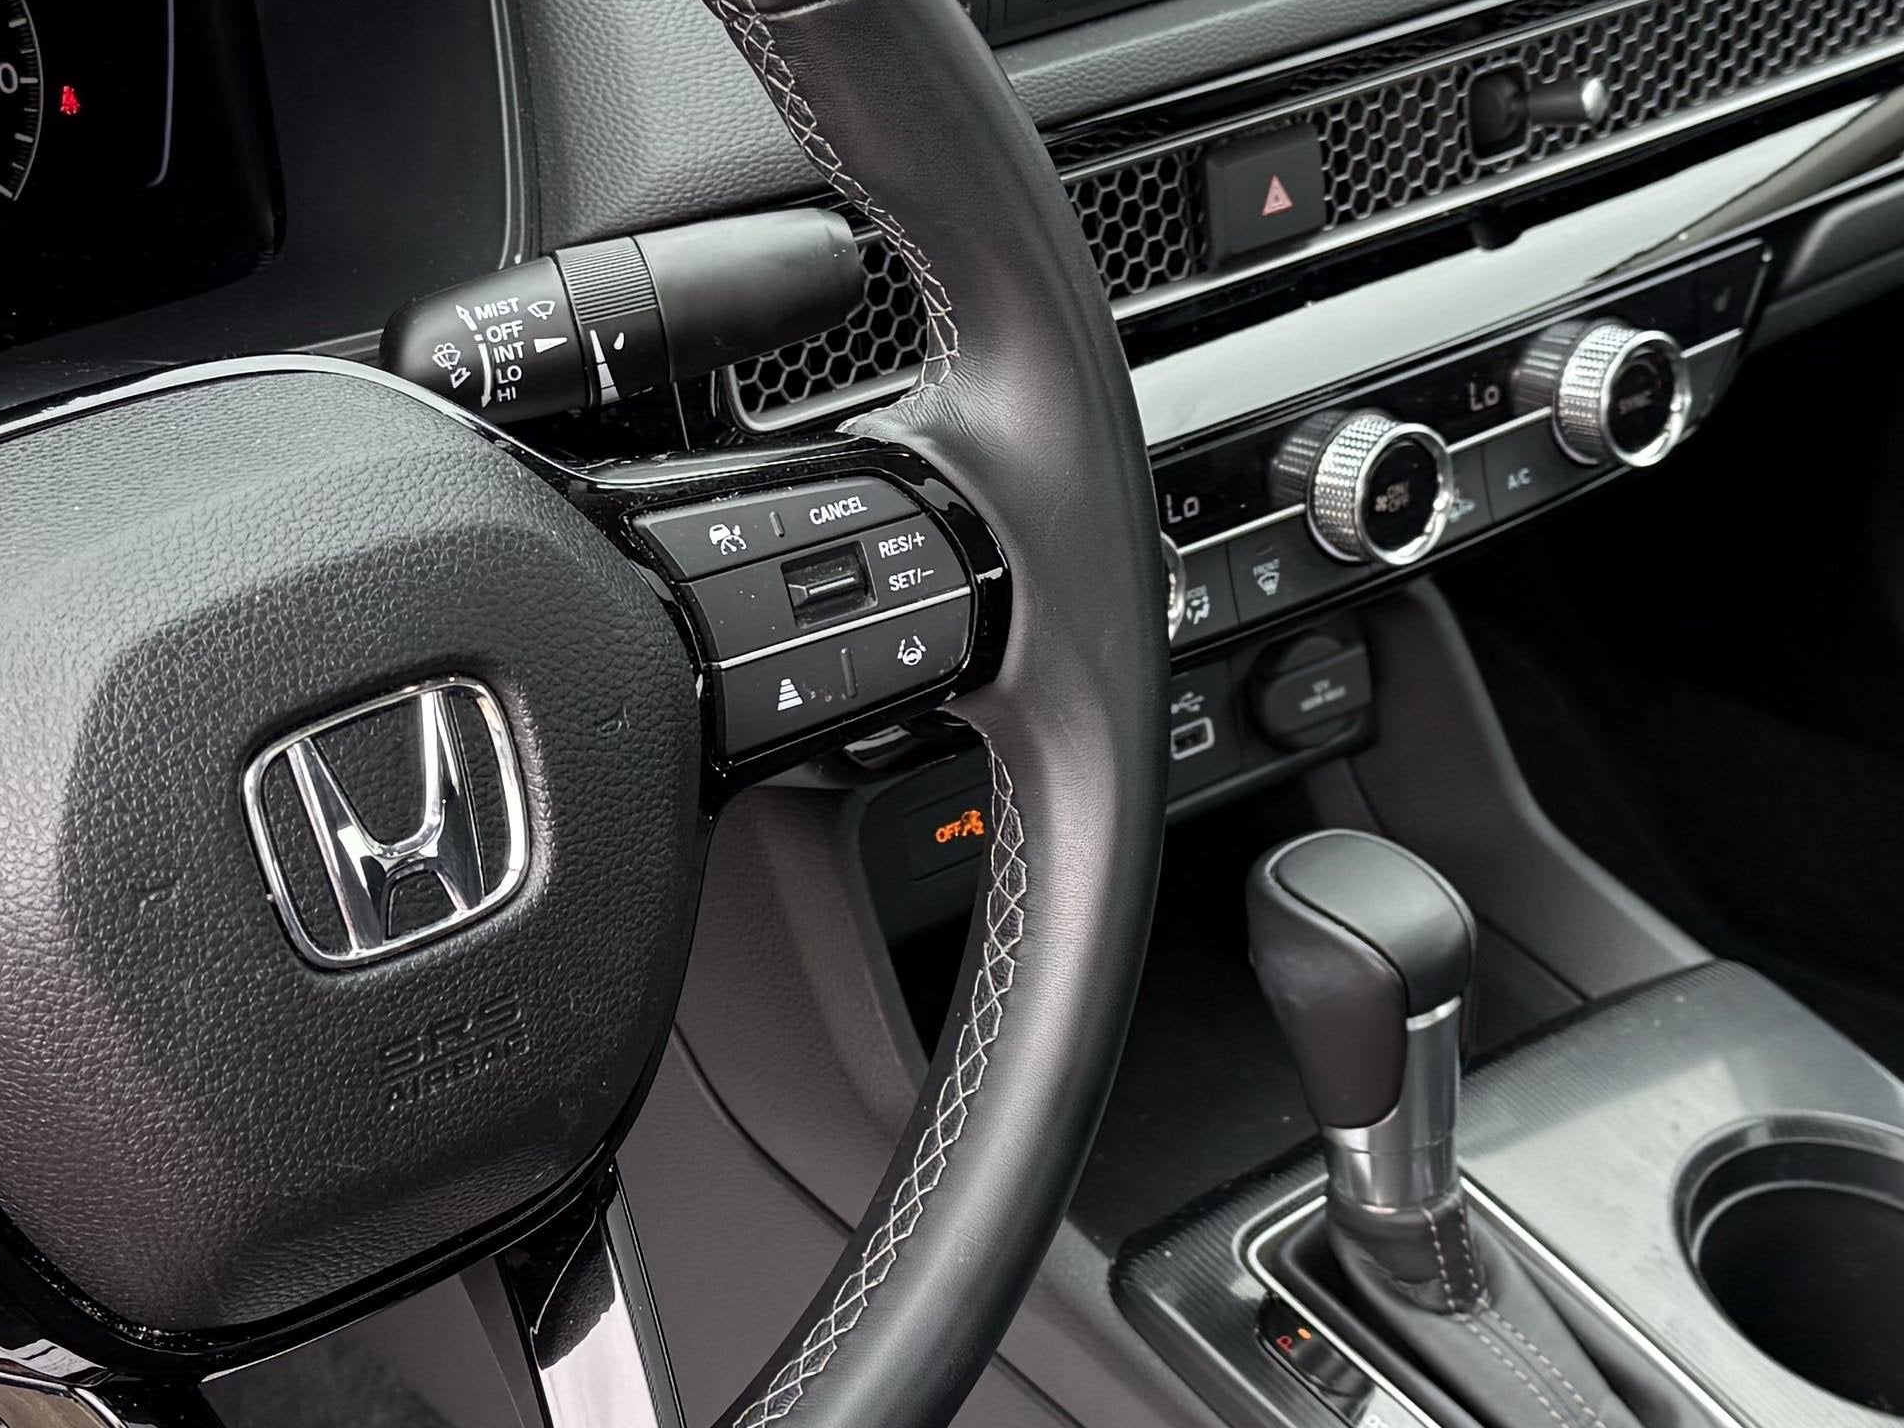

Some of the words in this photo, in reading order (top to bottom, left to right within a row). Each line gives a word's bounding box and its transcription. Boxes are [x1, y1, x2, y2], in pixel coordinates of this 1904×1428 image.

[474, 297, 520, 321] MIST
[486, 319, 524, 343] OFF
[493, 341, 525, 364] INT
[496, 365, 523, 385] LO
[497, 386, 517, 403] HI
[1507, 467, 1533, 491] A/C
[809, 495, 868, 525] CANCEL
[878, 531, 926, 559] RES/+
[935, 819, 962, 843] OFF
[1276, 1335, 1294, 1355] P
